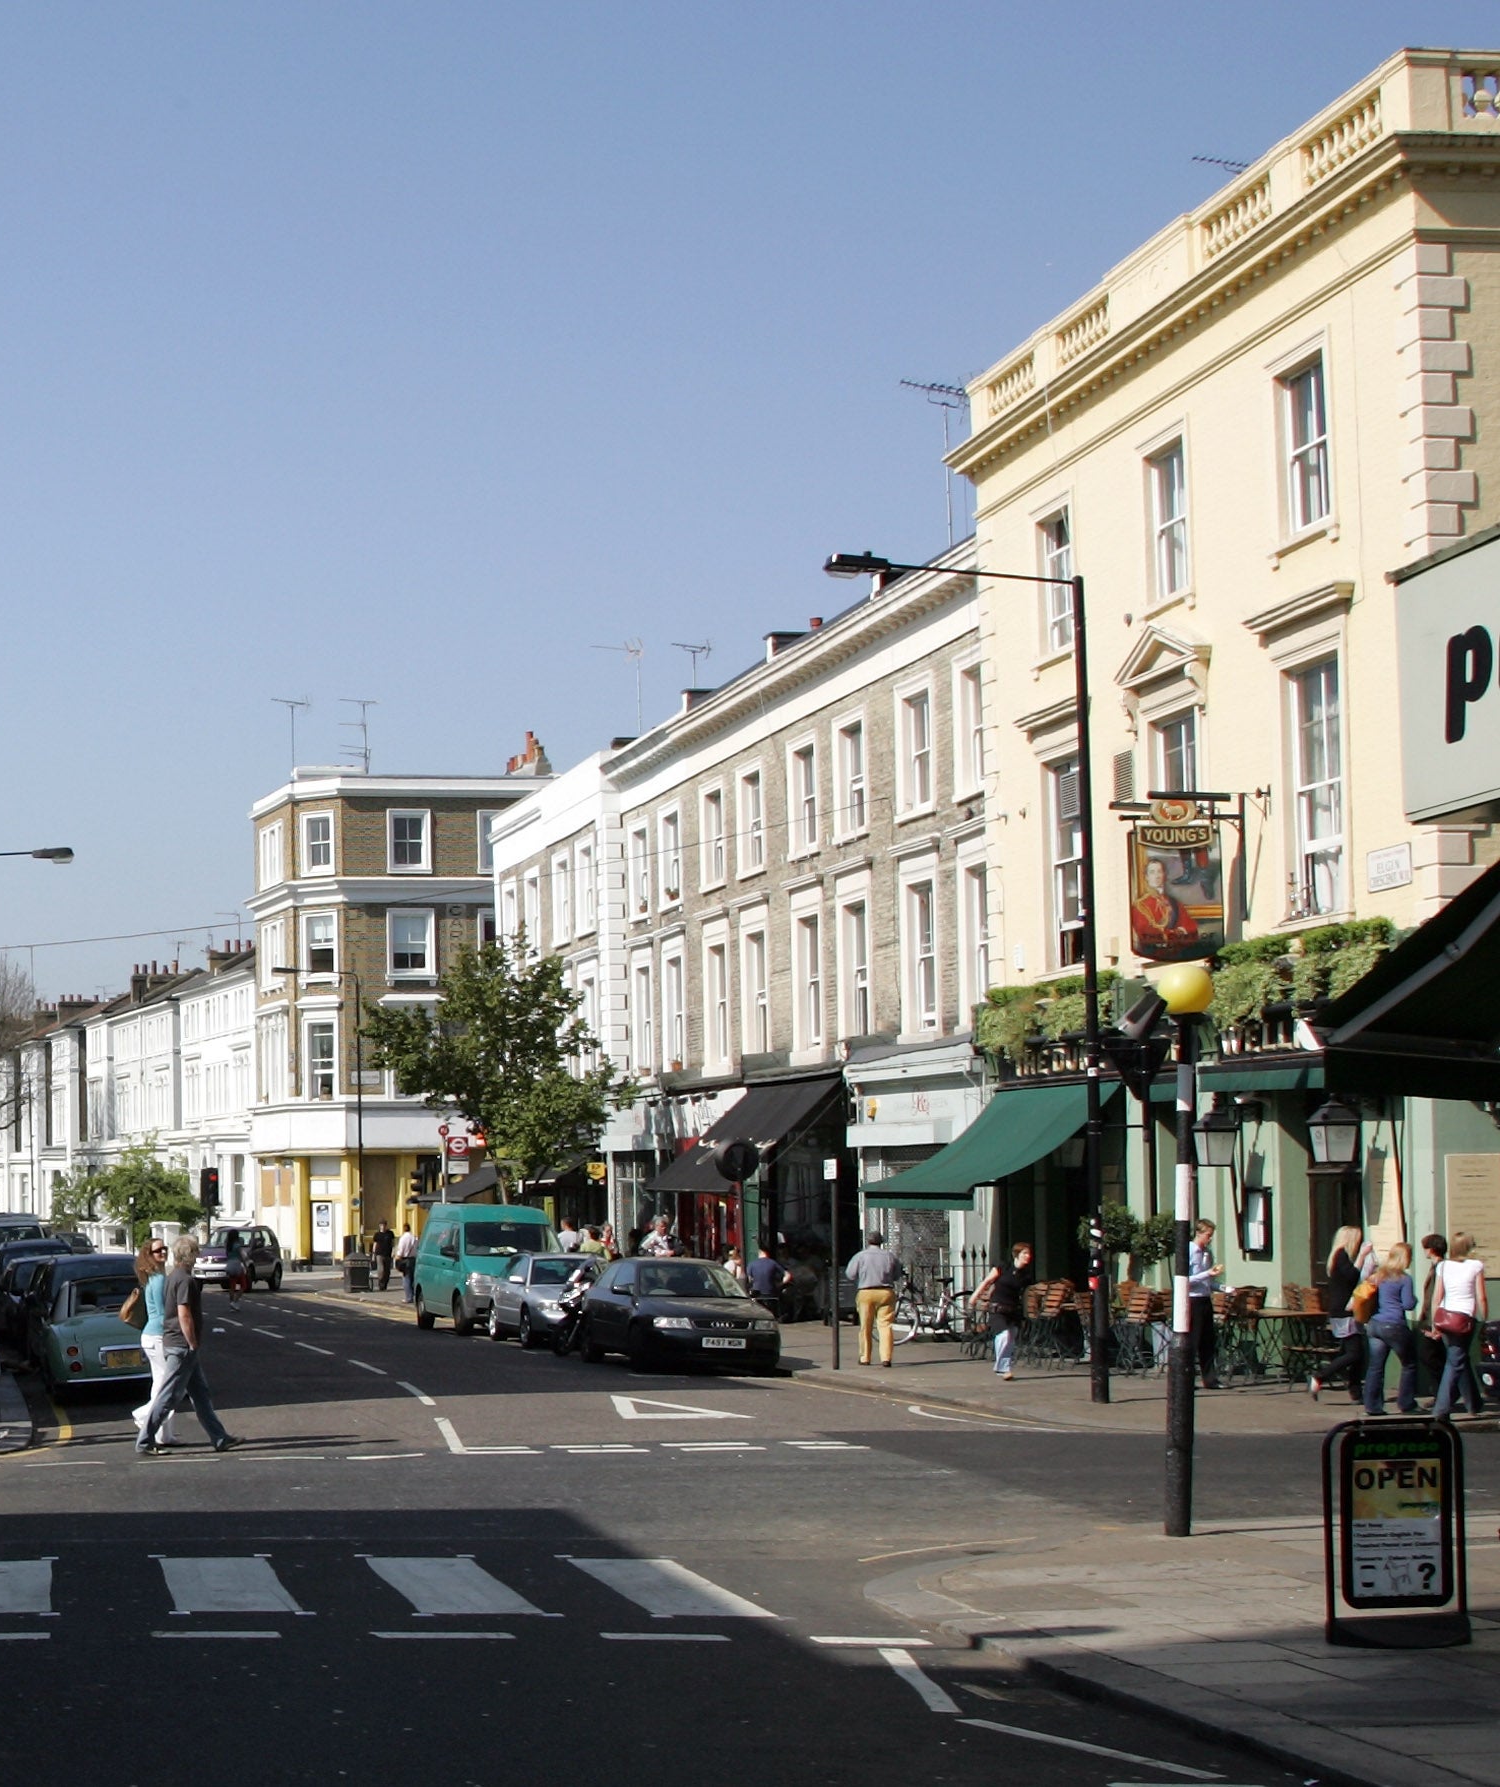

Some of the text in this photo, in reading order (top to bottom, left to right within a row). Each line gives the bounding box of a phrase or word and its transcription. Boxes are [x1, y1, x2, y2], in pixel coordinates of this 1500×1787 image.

[1144, 828, 1207, 843] YOUNG'S
[1353, 1442, 1439, 1458] progreso
[1354, 1466, 1437, 1491] OPEN
